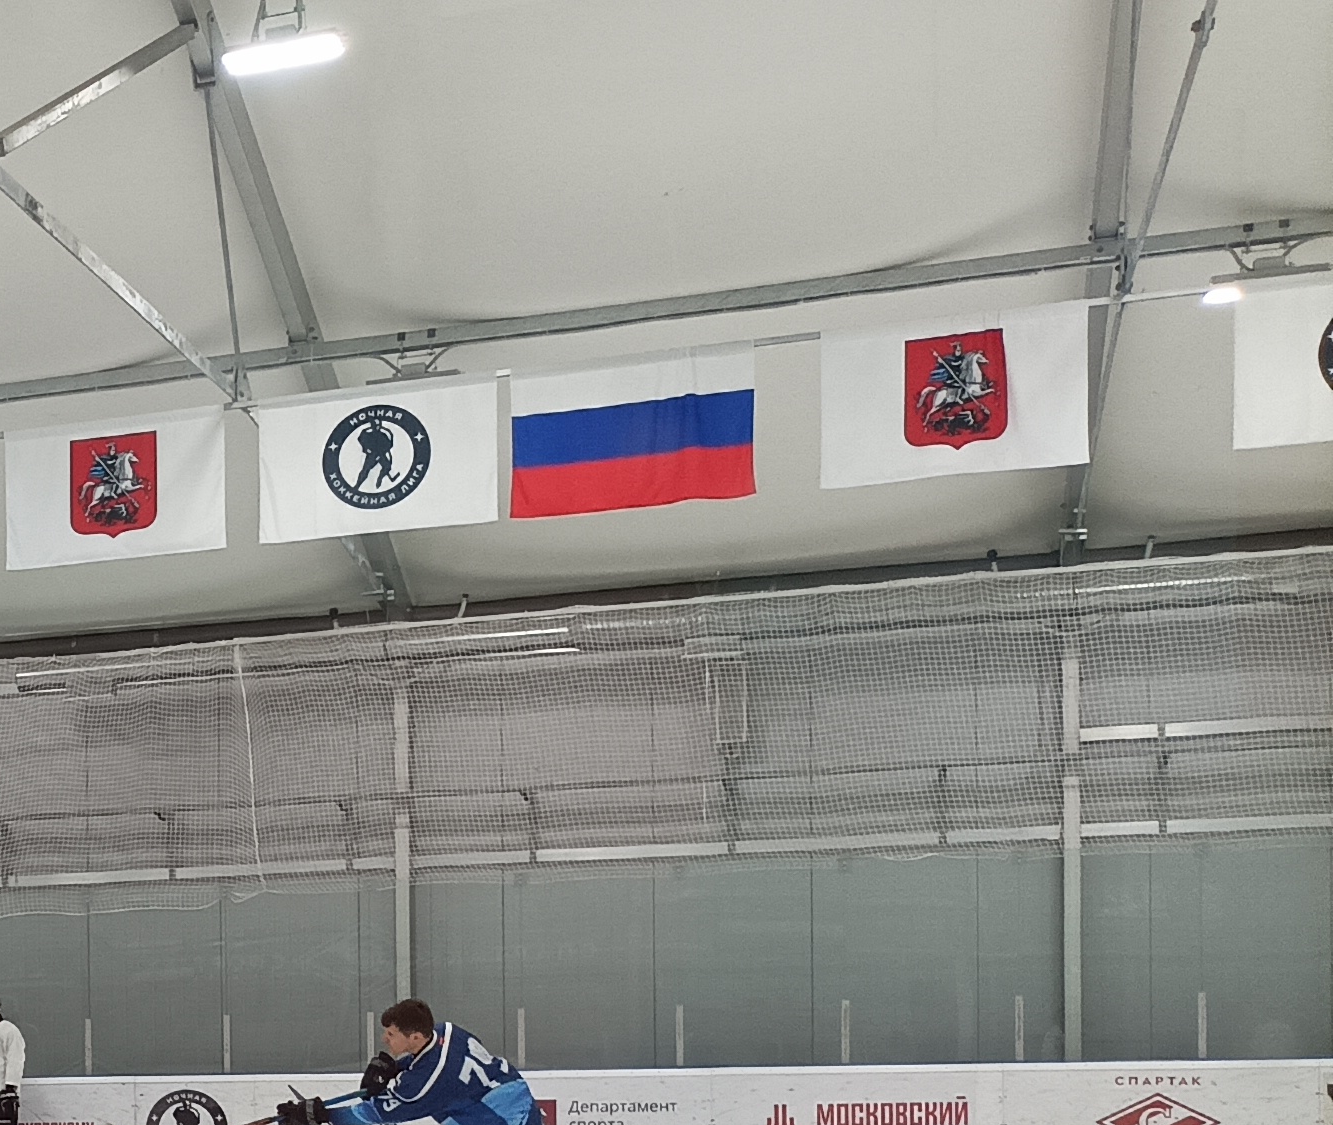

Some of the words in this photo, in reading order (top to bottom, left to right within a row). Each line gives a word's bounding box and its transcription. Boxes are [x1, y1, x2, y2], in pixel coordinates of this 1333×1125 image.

[349, 409, 403, 426] НОЧНАЯ
[329, 472, 396, 504] ХОККЕЙНАЯ
[400, 463, 424, 494] ЛИГА
[1114, 1076, 1201, 1086] СПАРТАК
[166, 1093, 207, 1104] НОЧНАЯ
[567, 1100, 678, 1116] Департамент
